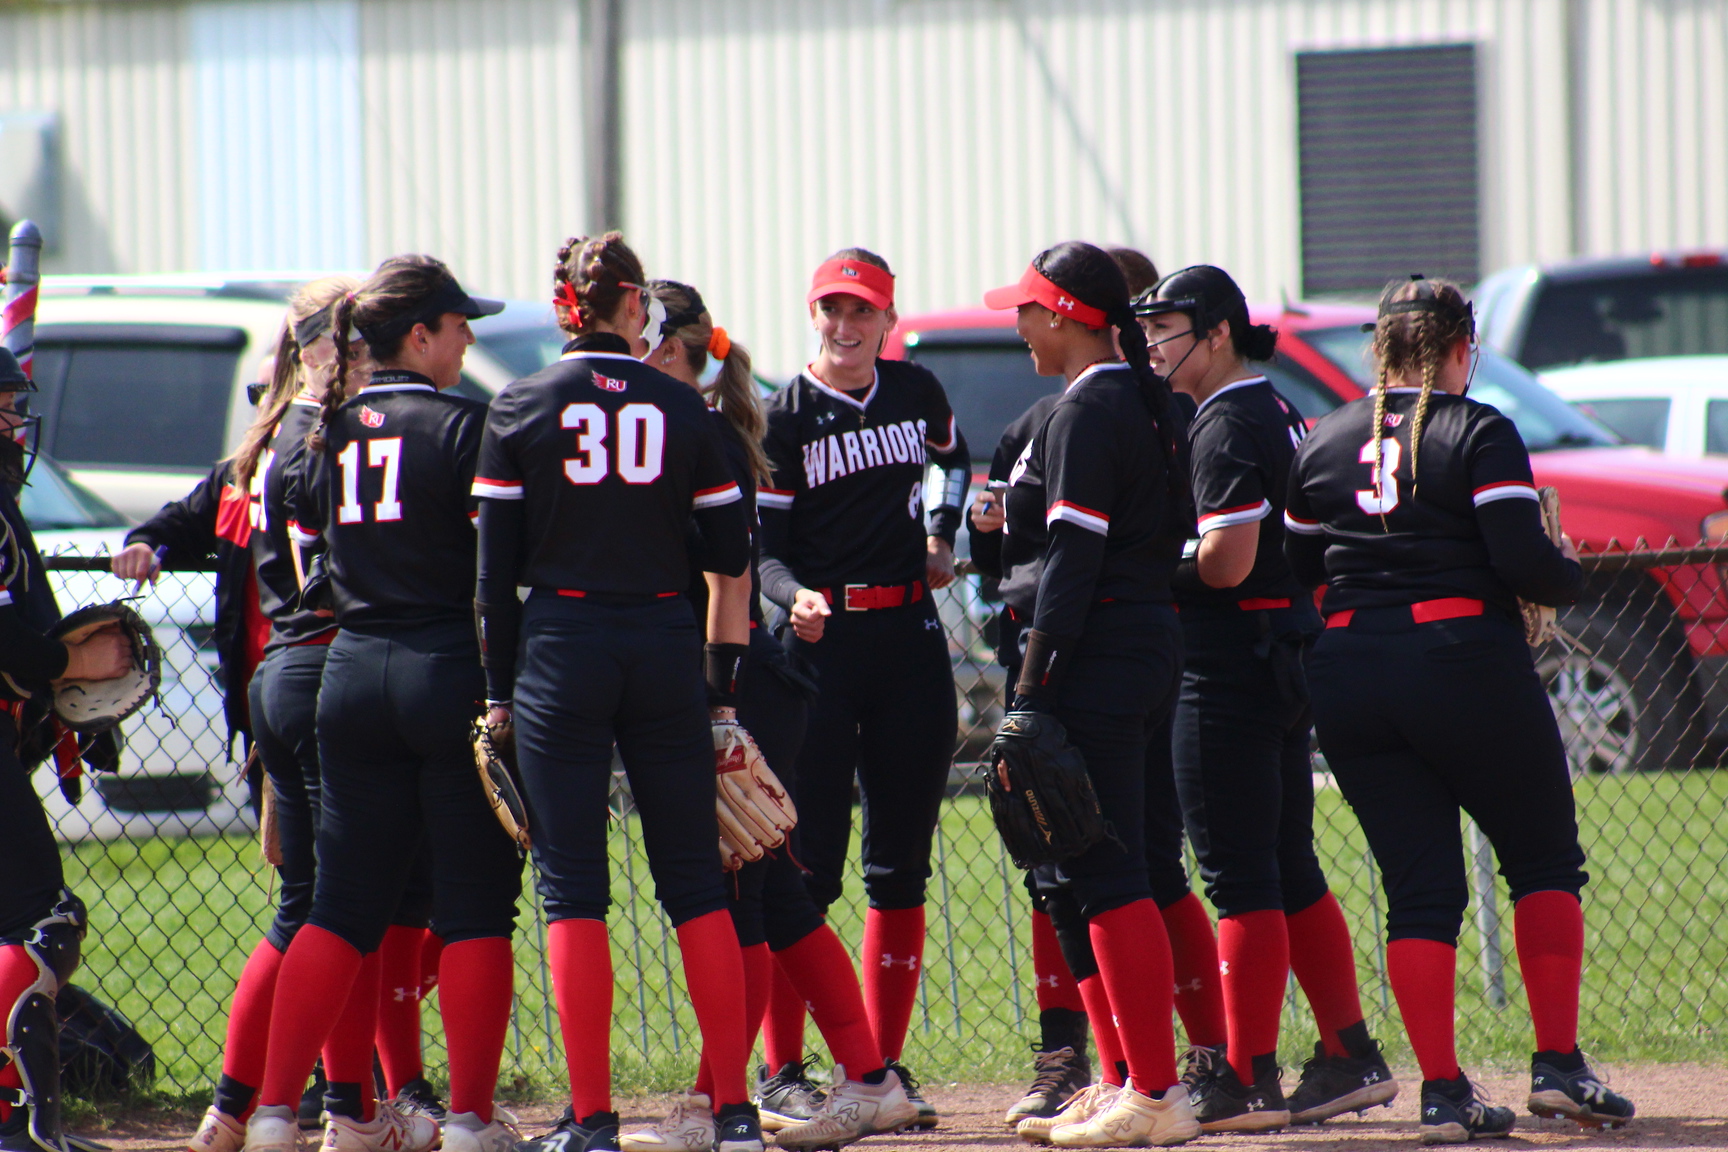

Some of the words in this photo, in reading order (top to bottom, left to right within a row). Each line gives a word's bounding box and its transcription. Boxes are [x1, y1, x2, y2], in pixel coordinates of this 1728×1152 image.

[605, 378, 627, 392] RU
[368, 411, 386, 427] RU
[1384, 412, 1404, 427] RU
[559, 402, 667, 486] 30
[337, 436, 403, 525] 17
[1355, 436, 1402, 516] 3
